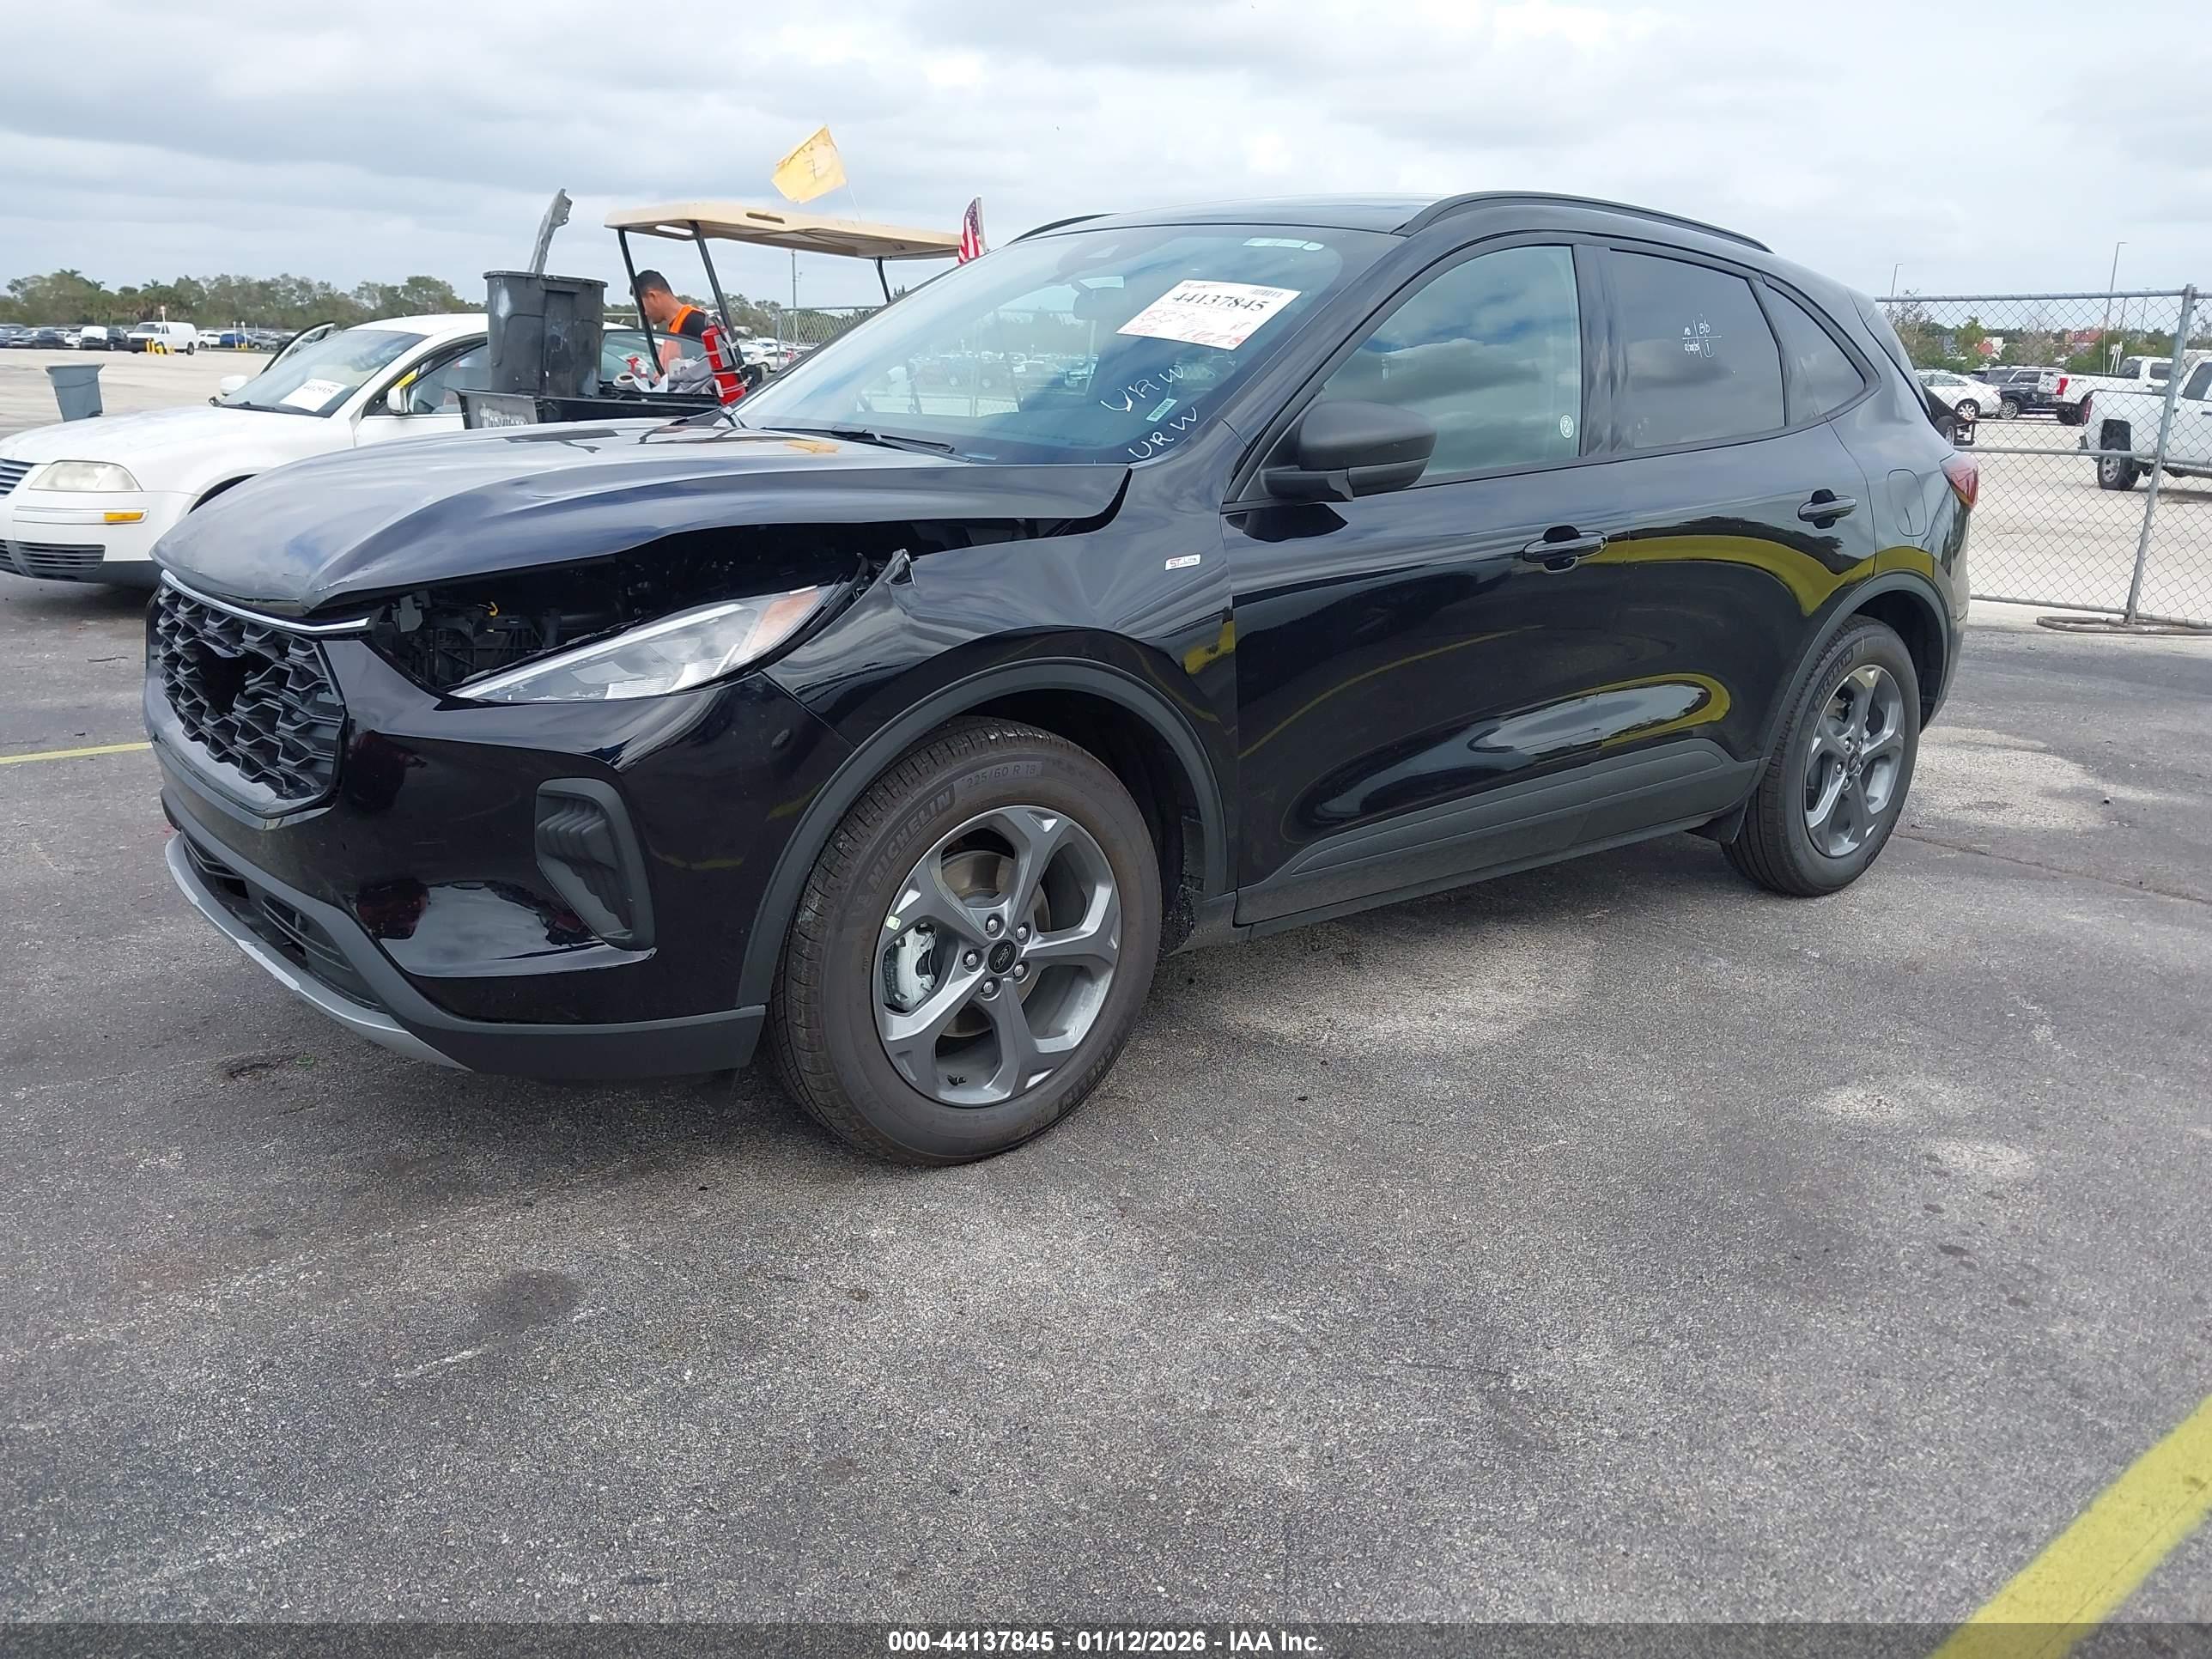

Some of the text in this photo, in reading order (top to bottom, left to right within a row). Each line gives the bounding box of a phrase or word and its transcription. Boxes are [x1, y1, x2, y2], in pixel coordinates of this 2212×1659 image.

[1172, 293, 1269, 312] 44137845
[1813, 649, 1851, 709] MICHELIN
[966, 764, 1036, 788] 225/60 R 18
[866, 789, 951, 890] MICHELIN
